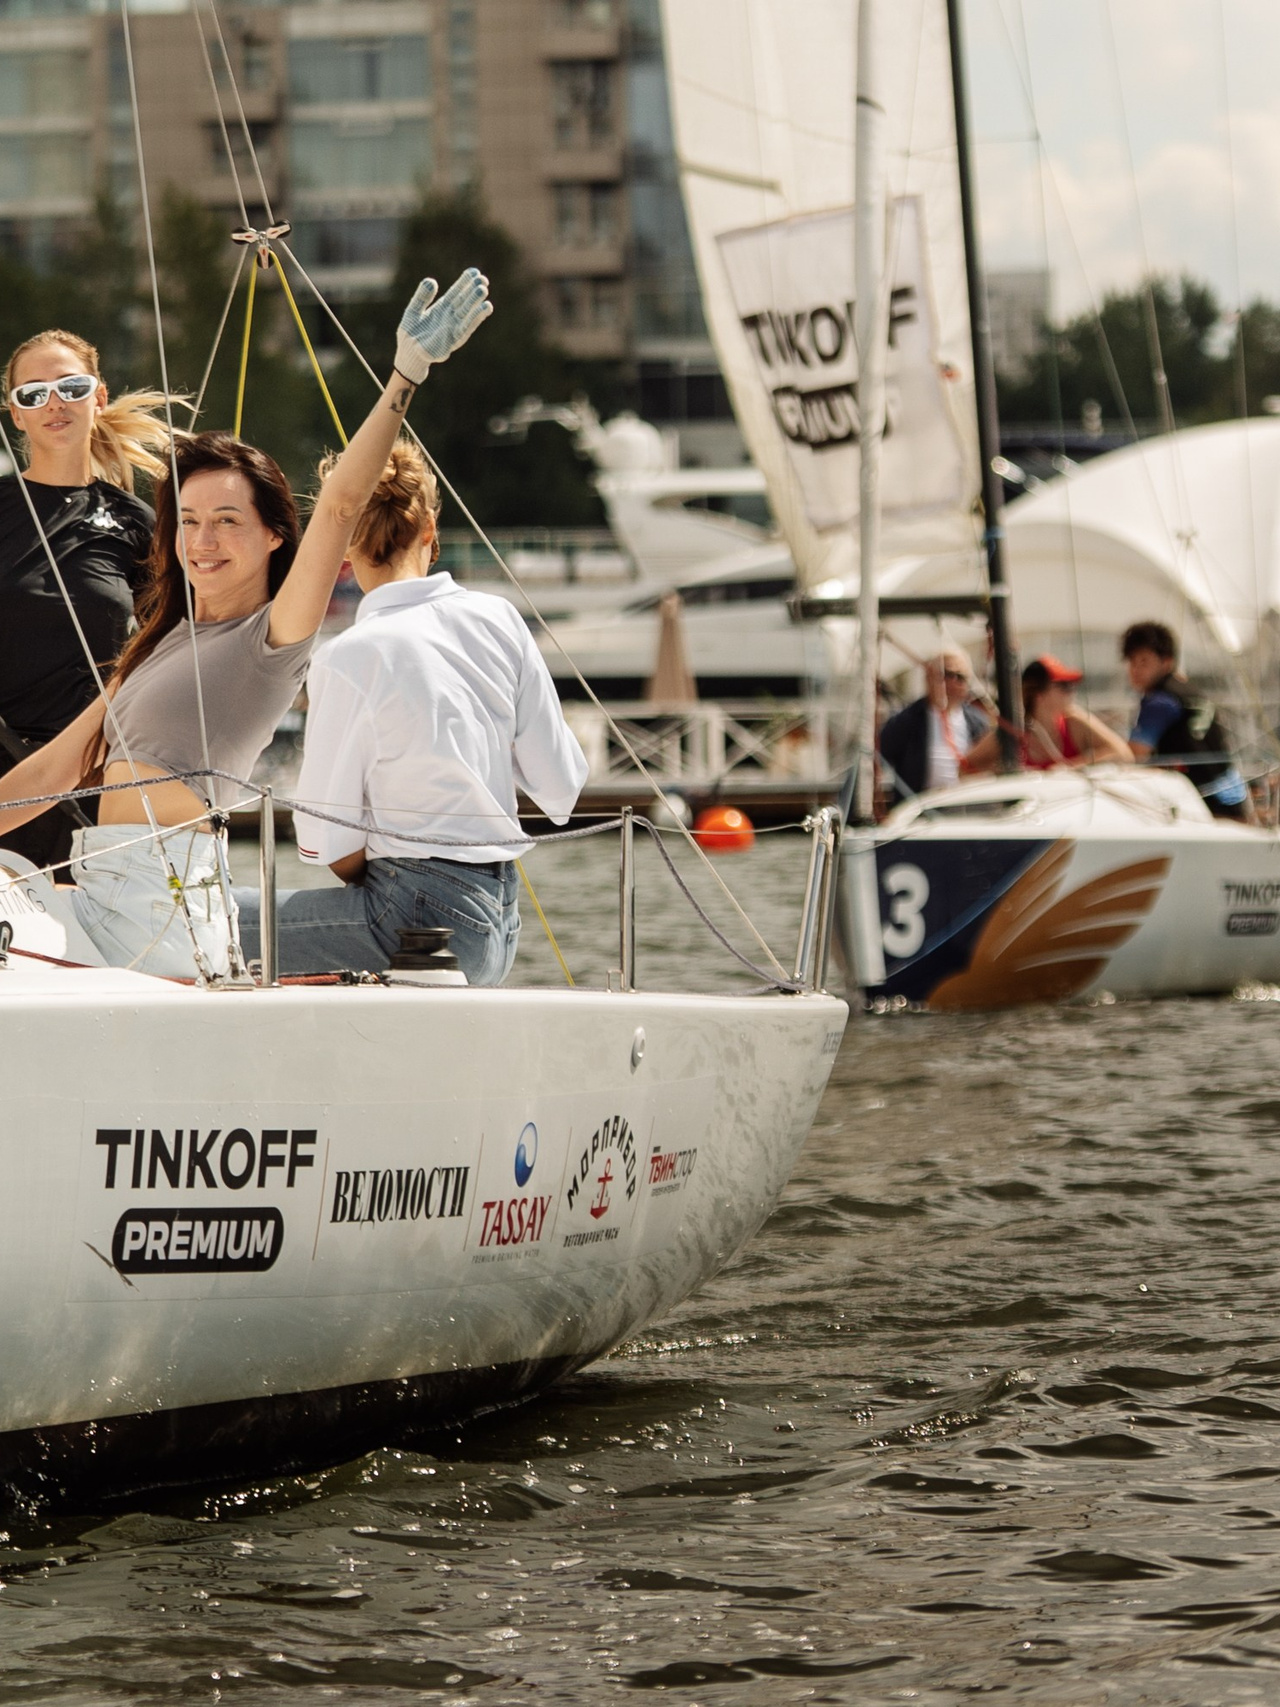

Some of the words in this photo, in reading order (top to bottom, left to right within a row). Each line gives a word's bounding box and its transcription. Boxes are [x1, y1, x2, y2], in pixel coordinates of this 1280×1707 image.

[883, 862, 930, 959] 3
[95, 1128, 318, 1190] TINKOFF
[329, 1166, 471, 1230] ВЕДОМОСТИ
[479, 1195, 553, 1247] TASSAY
[122, 1220, 276, 1261] PREMIUM
